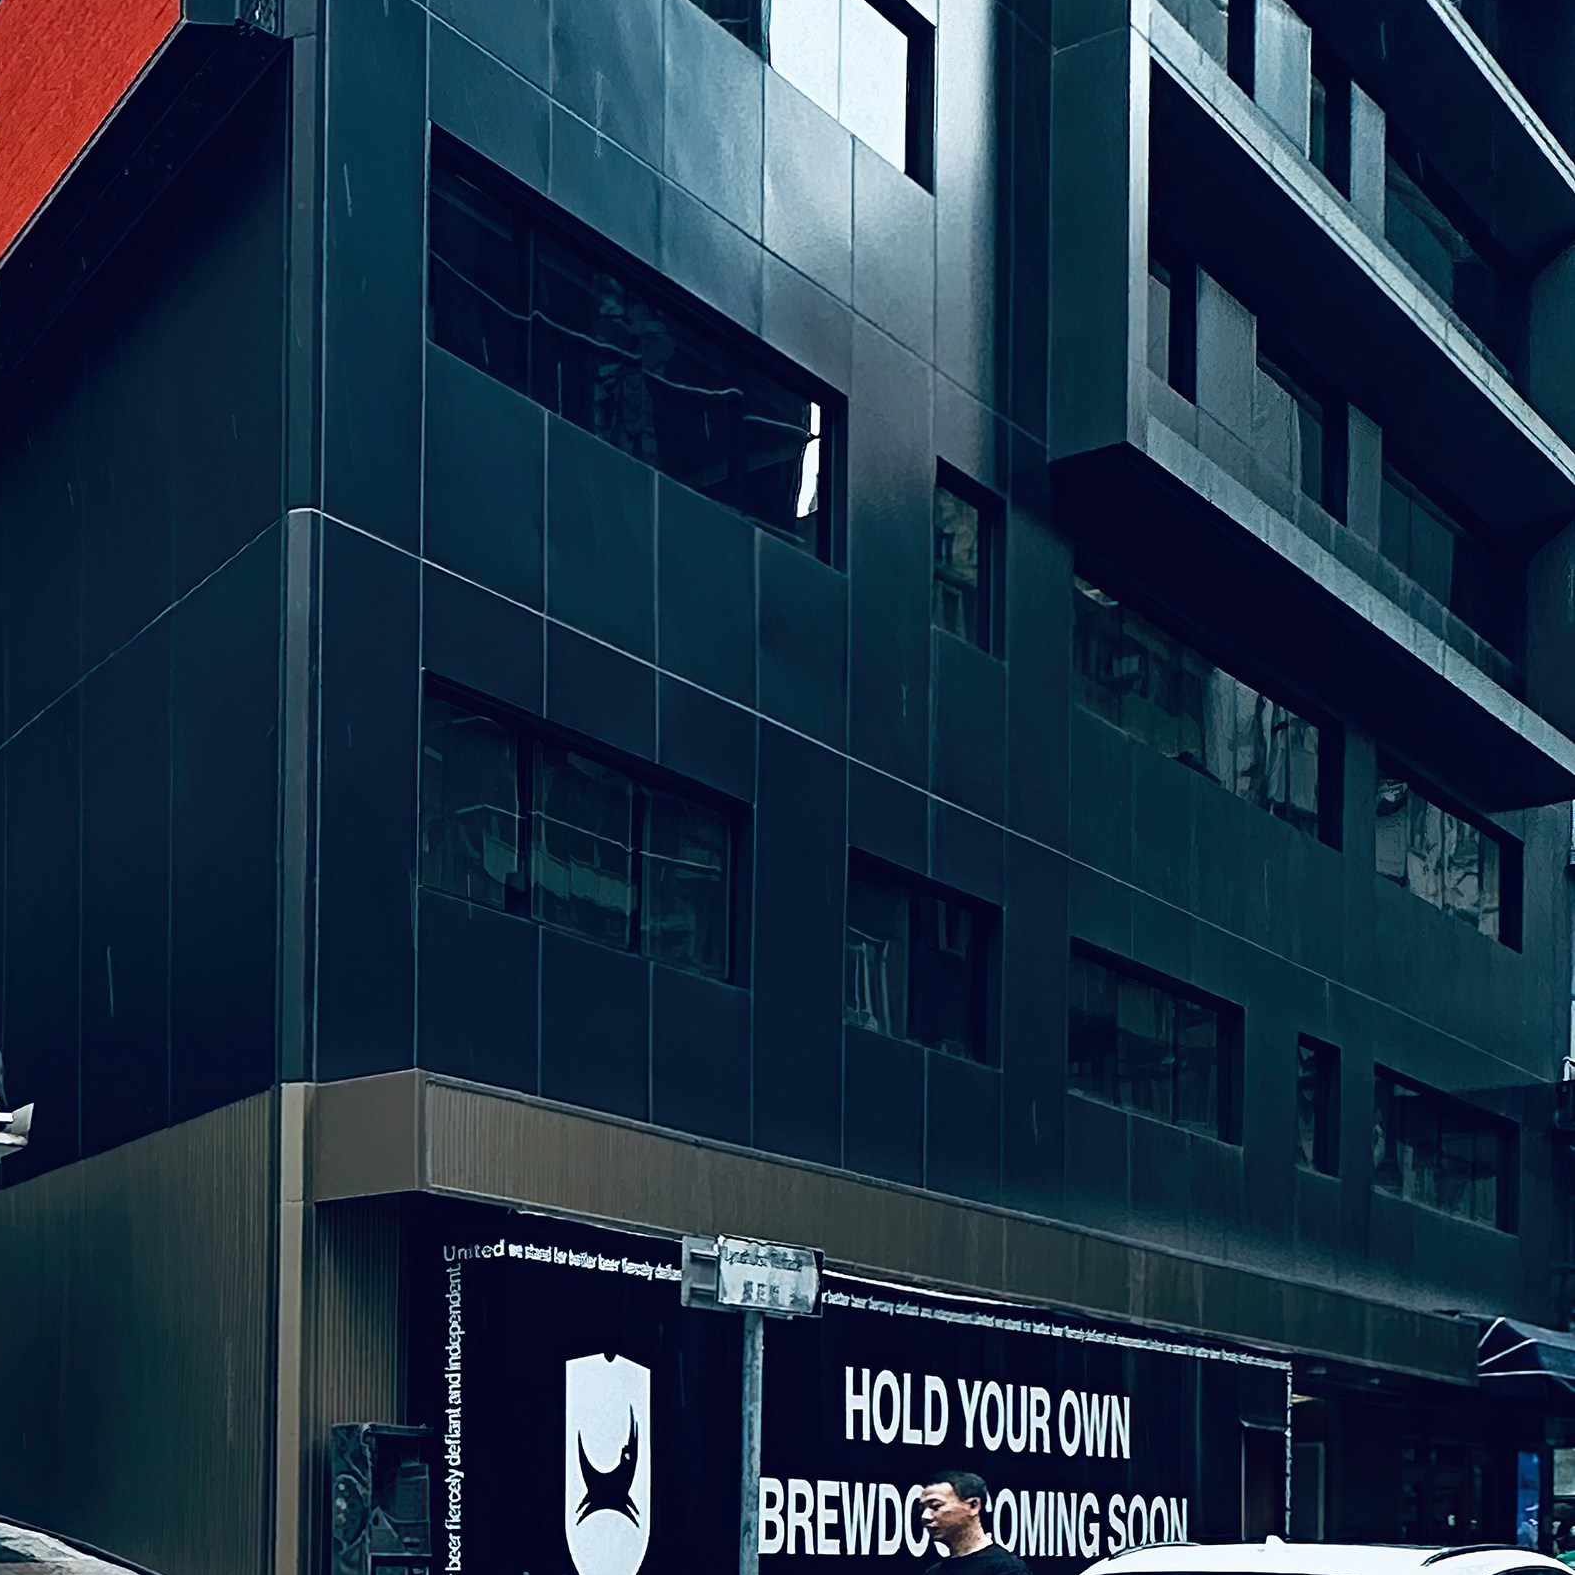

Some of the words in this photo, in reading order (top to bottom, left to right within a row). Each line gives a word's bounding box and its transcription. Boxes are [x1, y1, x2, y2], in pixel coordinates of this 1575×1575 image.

[443, 1239, 506, 1262] United
[444, 1373, 462, 1405] and
[845, 1366, 949, 1446] HOLD
[957, 1379, 1051, 1453] YOUR
[1058, 1390, 1131, 1459] OWN
[444, 1407, 462, 1466] defiant
[444, 1468, 465, 1530] fiercely
[758, 1477, 950, 1559] BREWDO
[985, 1488, 1100, 1559] OMING
[1108, 1493, 1188, 1553] SOON
[445, 1533, 462, 1571] beer
